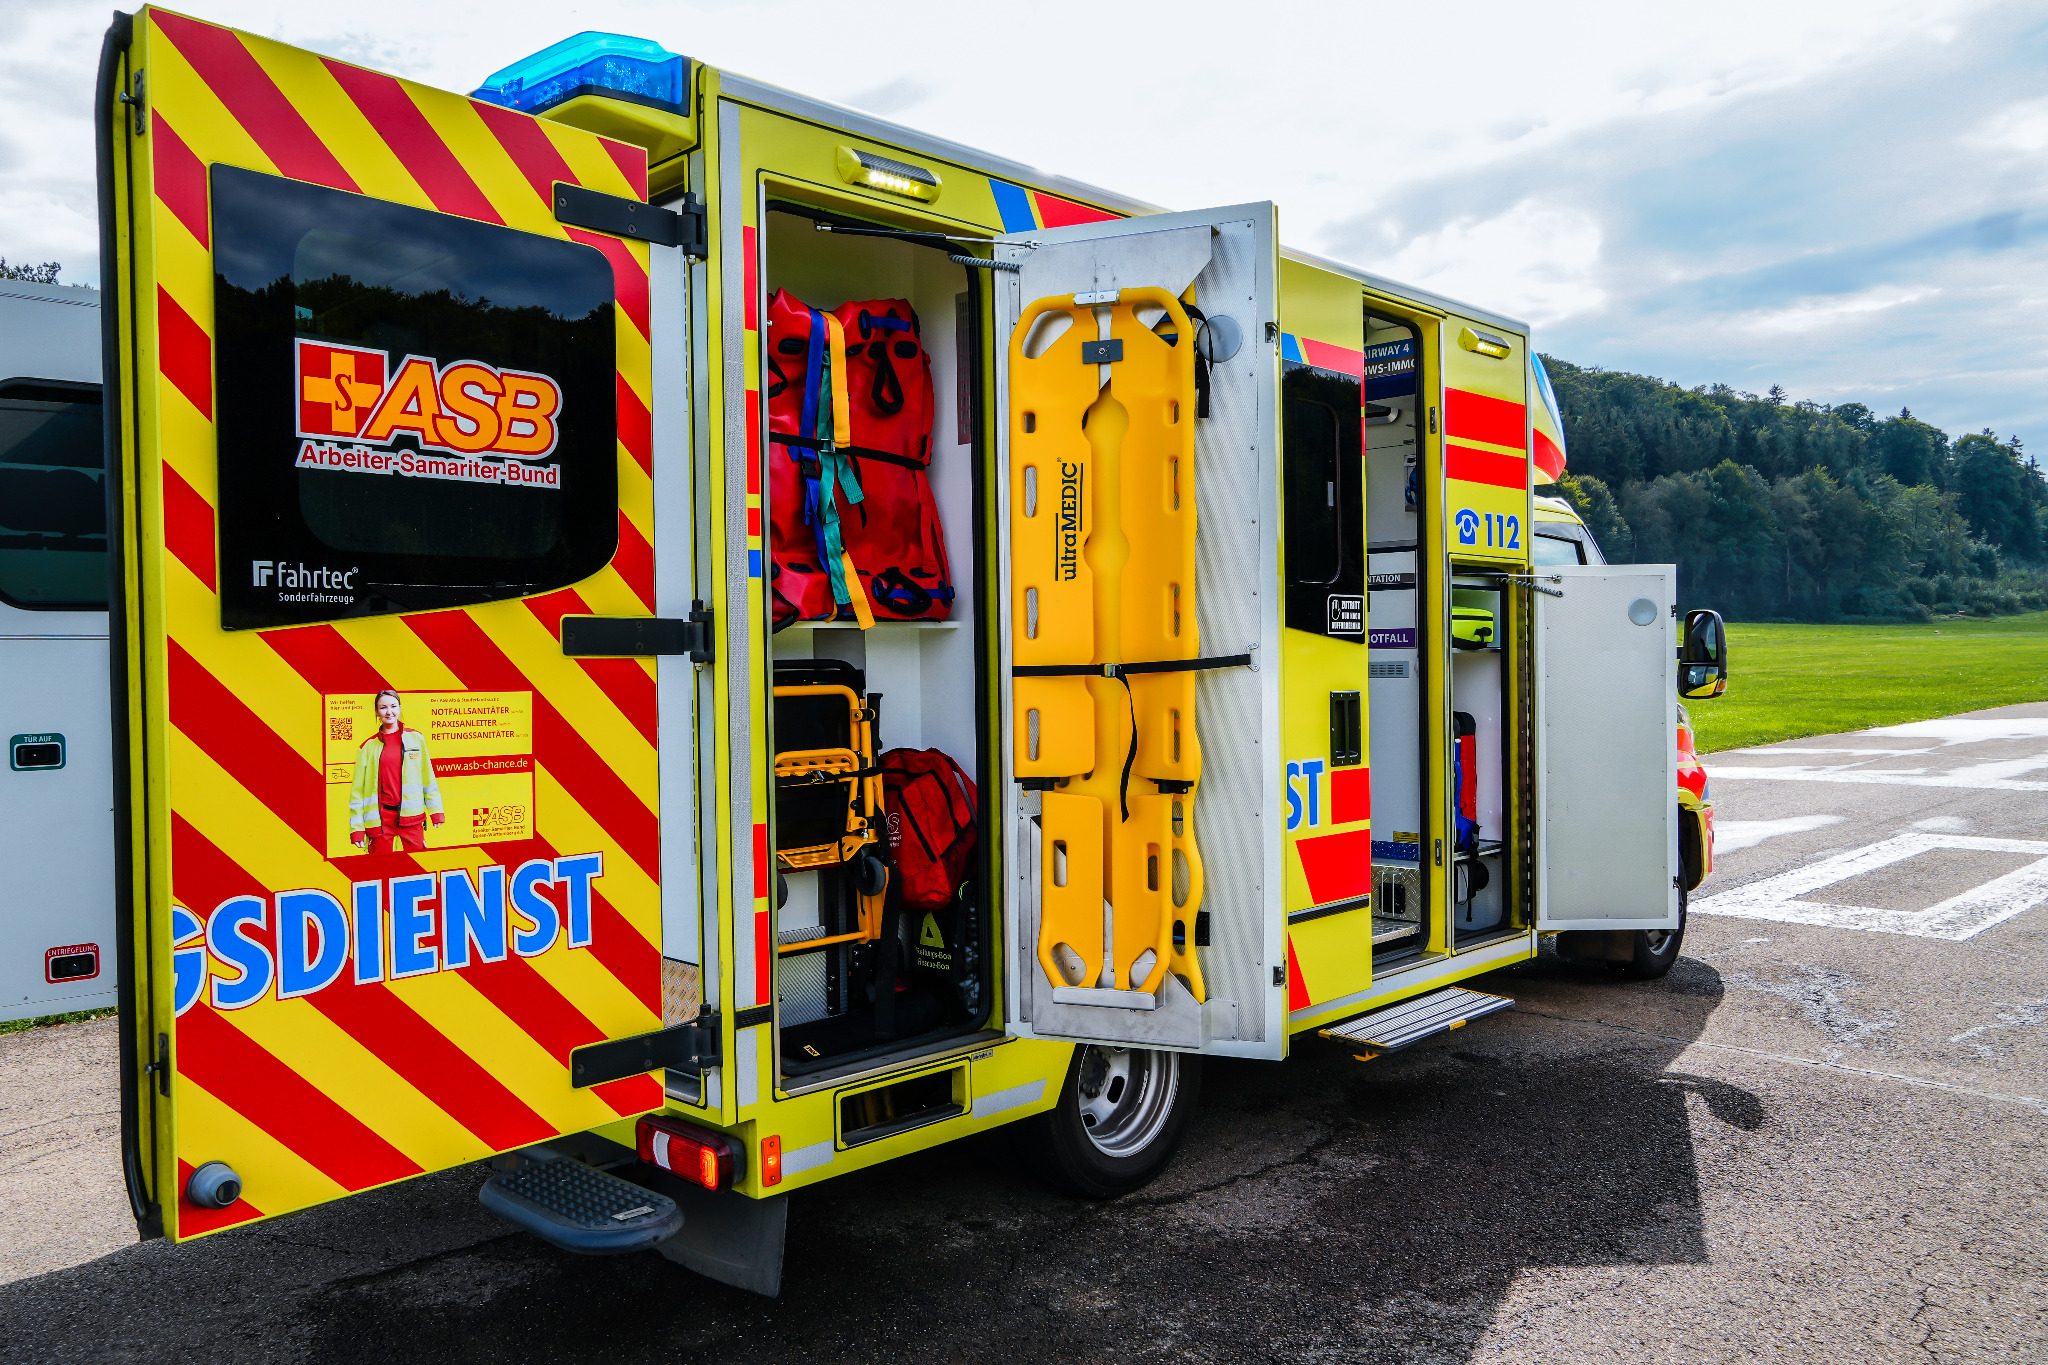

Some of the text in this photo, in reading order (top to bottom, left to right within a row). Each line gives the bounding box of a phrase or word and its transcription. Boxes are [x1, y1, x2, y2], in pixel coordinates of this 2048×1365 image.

[1402, 343, 1410, 353] 4
[360, 353, 564, 461] ASB
[299, 442, 559, 487] Arbeiter-Samariter-Bund
[1061, 462, 1078, 581] ultraMEDIC
[1484, 511, 1521, 550] 112
[278, 592, 355, 604] Sonderfahrzeuge
[1368, 633, 1409, 644] OTFALL
[431, 705, 510, 716] NOTFALLSANITÄTER
[431, 719, 497, 729] PRAXISANLEITER
[24, 734, 53, 743] TÜR AUF
[431, 729, 515, 741] RETTUNGSSANITÄTER
[436, 757, 529, 772] www.asb-chance.de
[486, 804, 526, 826] ASB
[47, 944, 97, 957] ENTRIEGELUNG
